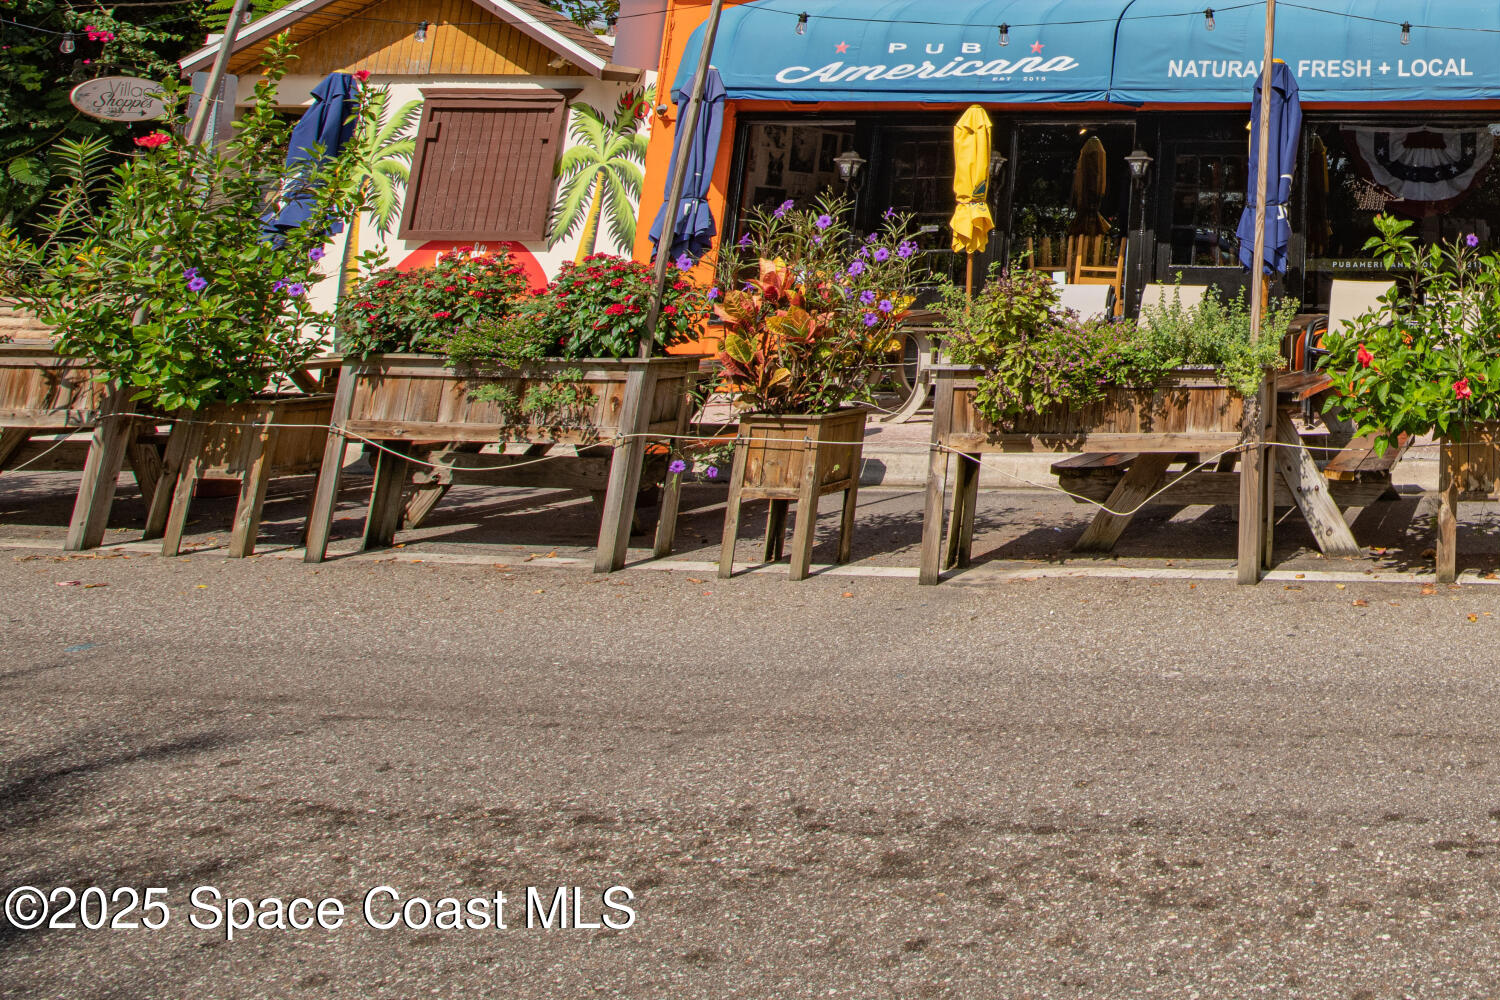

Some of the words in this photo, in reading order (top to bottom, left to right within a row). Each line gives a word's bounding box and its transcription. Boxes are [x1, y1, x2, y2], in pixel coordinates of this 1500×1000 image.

[888, 42, 982, 55] PUB
[775, 55, 1081, 84] Americana
[1297, 59, 1371, 78] FRESH
[1398, 58, 1474, 77] LOCAL
